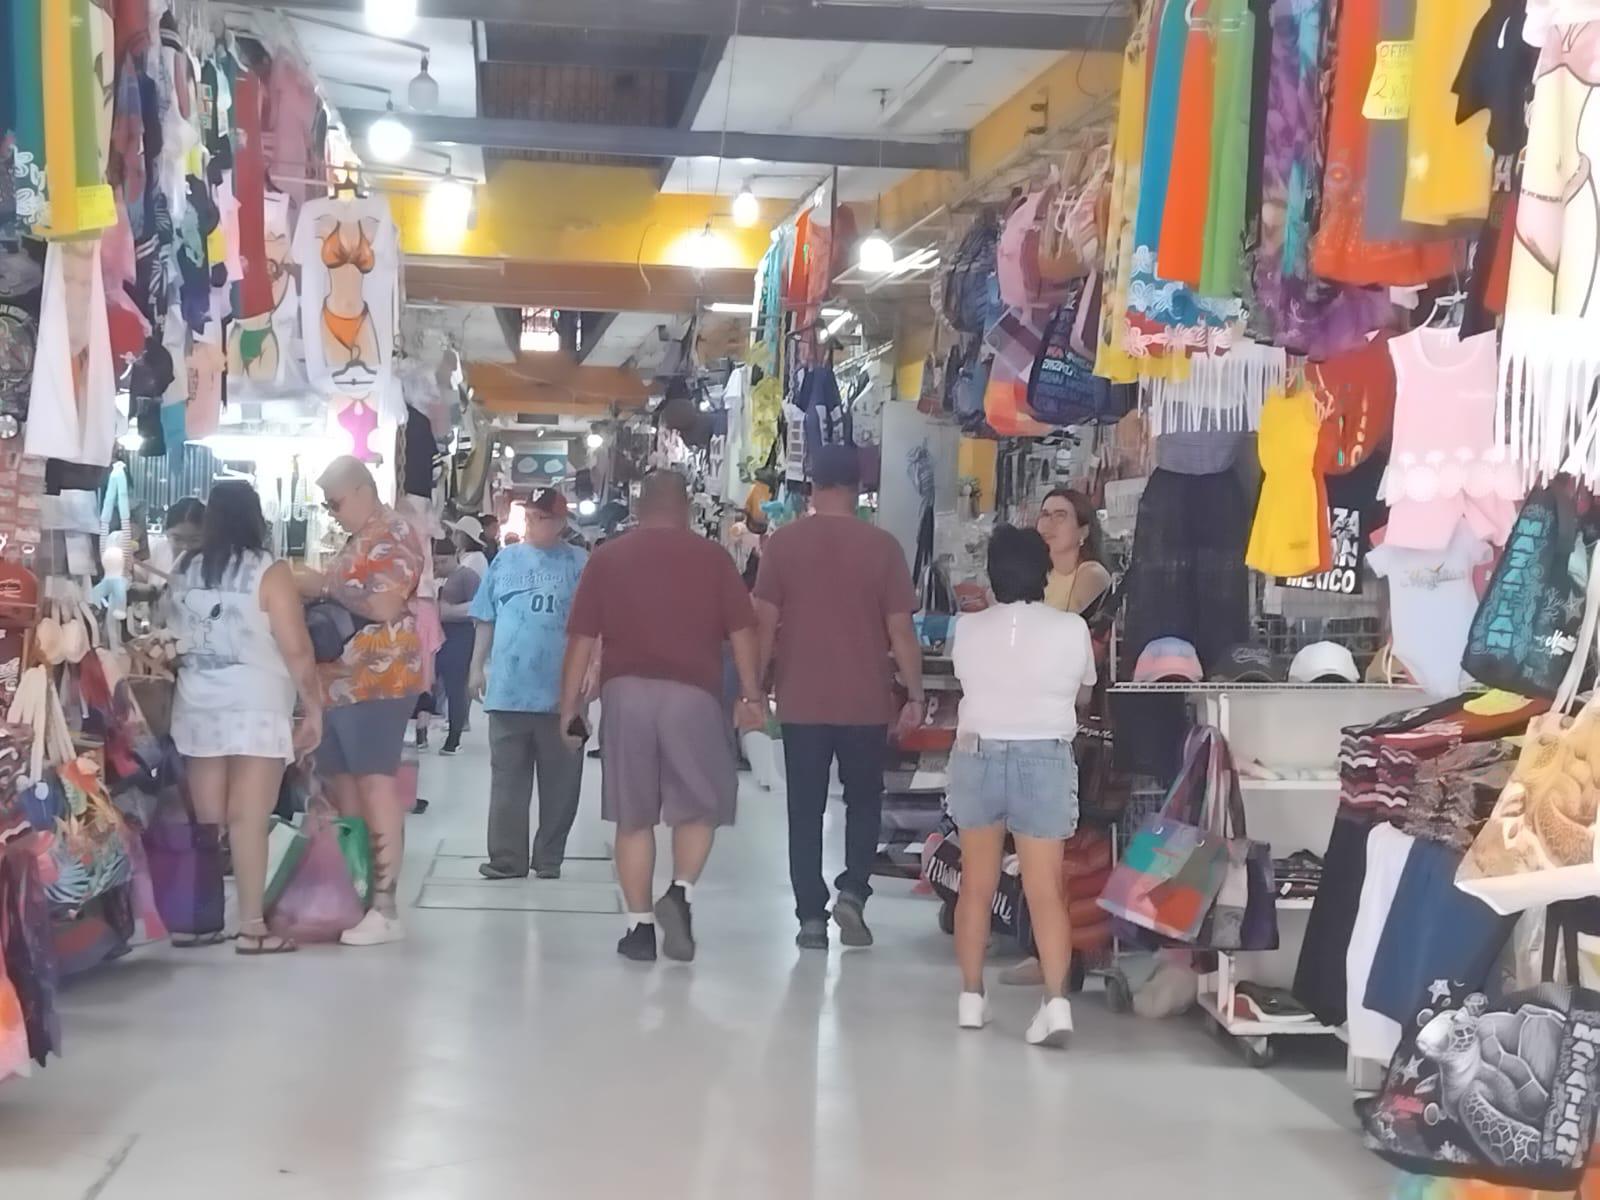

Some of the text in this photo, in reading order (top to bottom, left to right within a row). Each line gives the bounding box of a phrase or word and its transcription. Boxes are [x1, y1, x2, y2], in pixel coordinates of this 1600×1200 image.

[530, 593, 555, 614] 01
[1486, 518, 1543, 649] MAZATLAN
[1554, 1022, 1600, 1156] MAZATLAN
